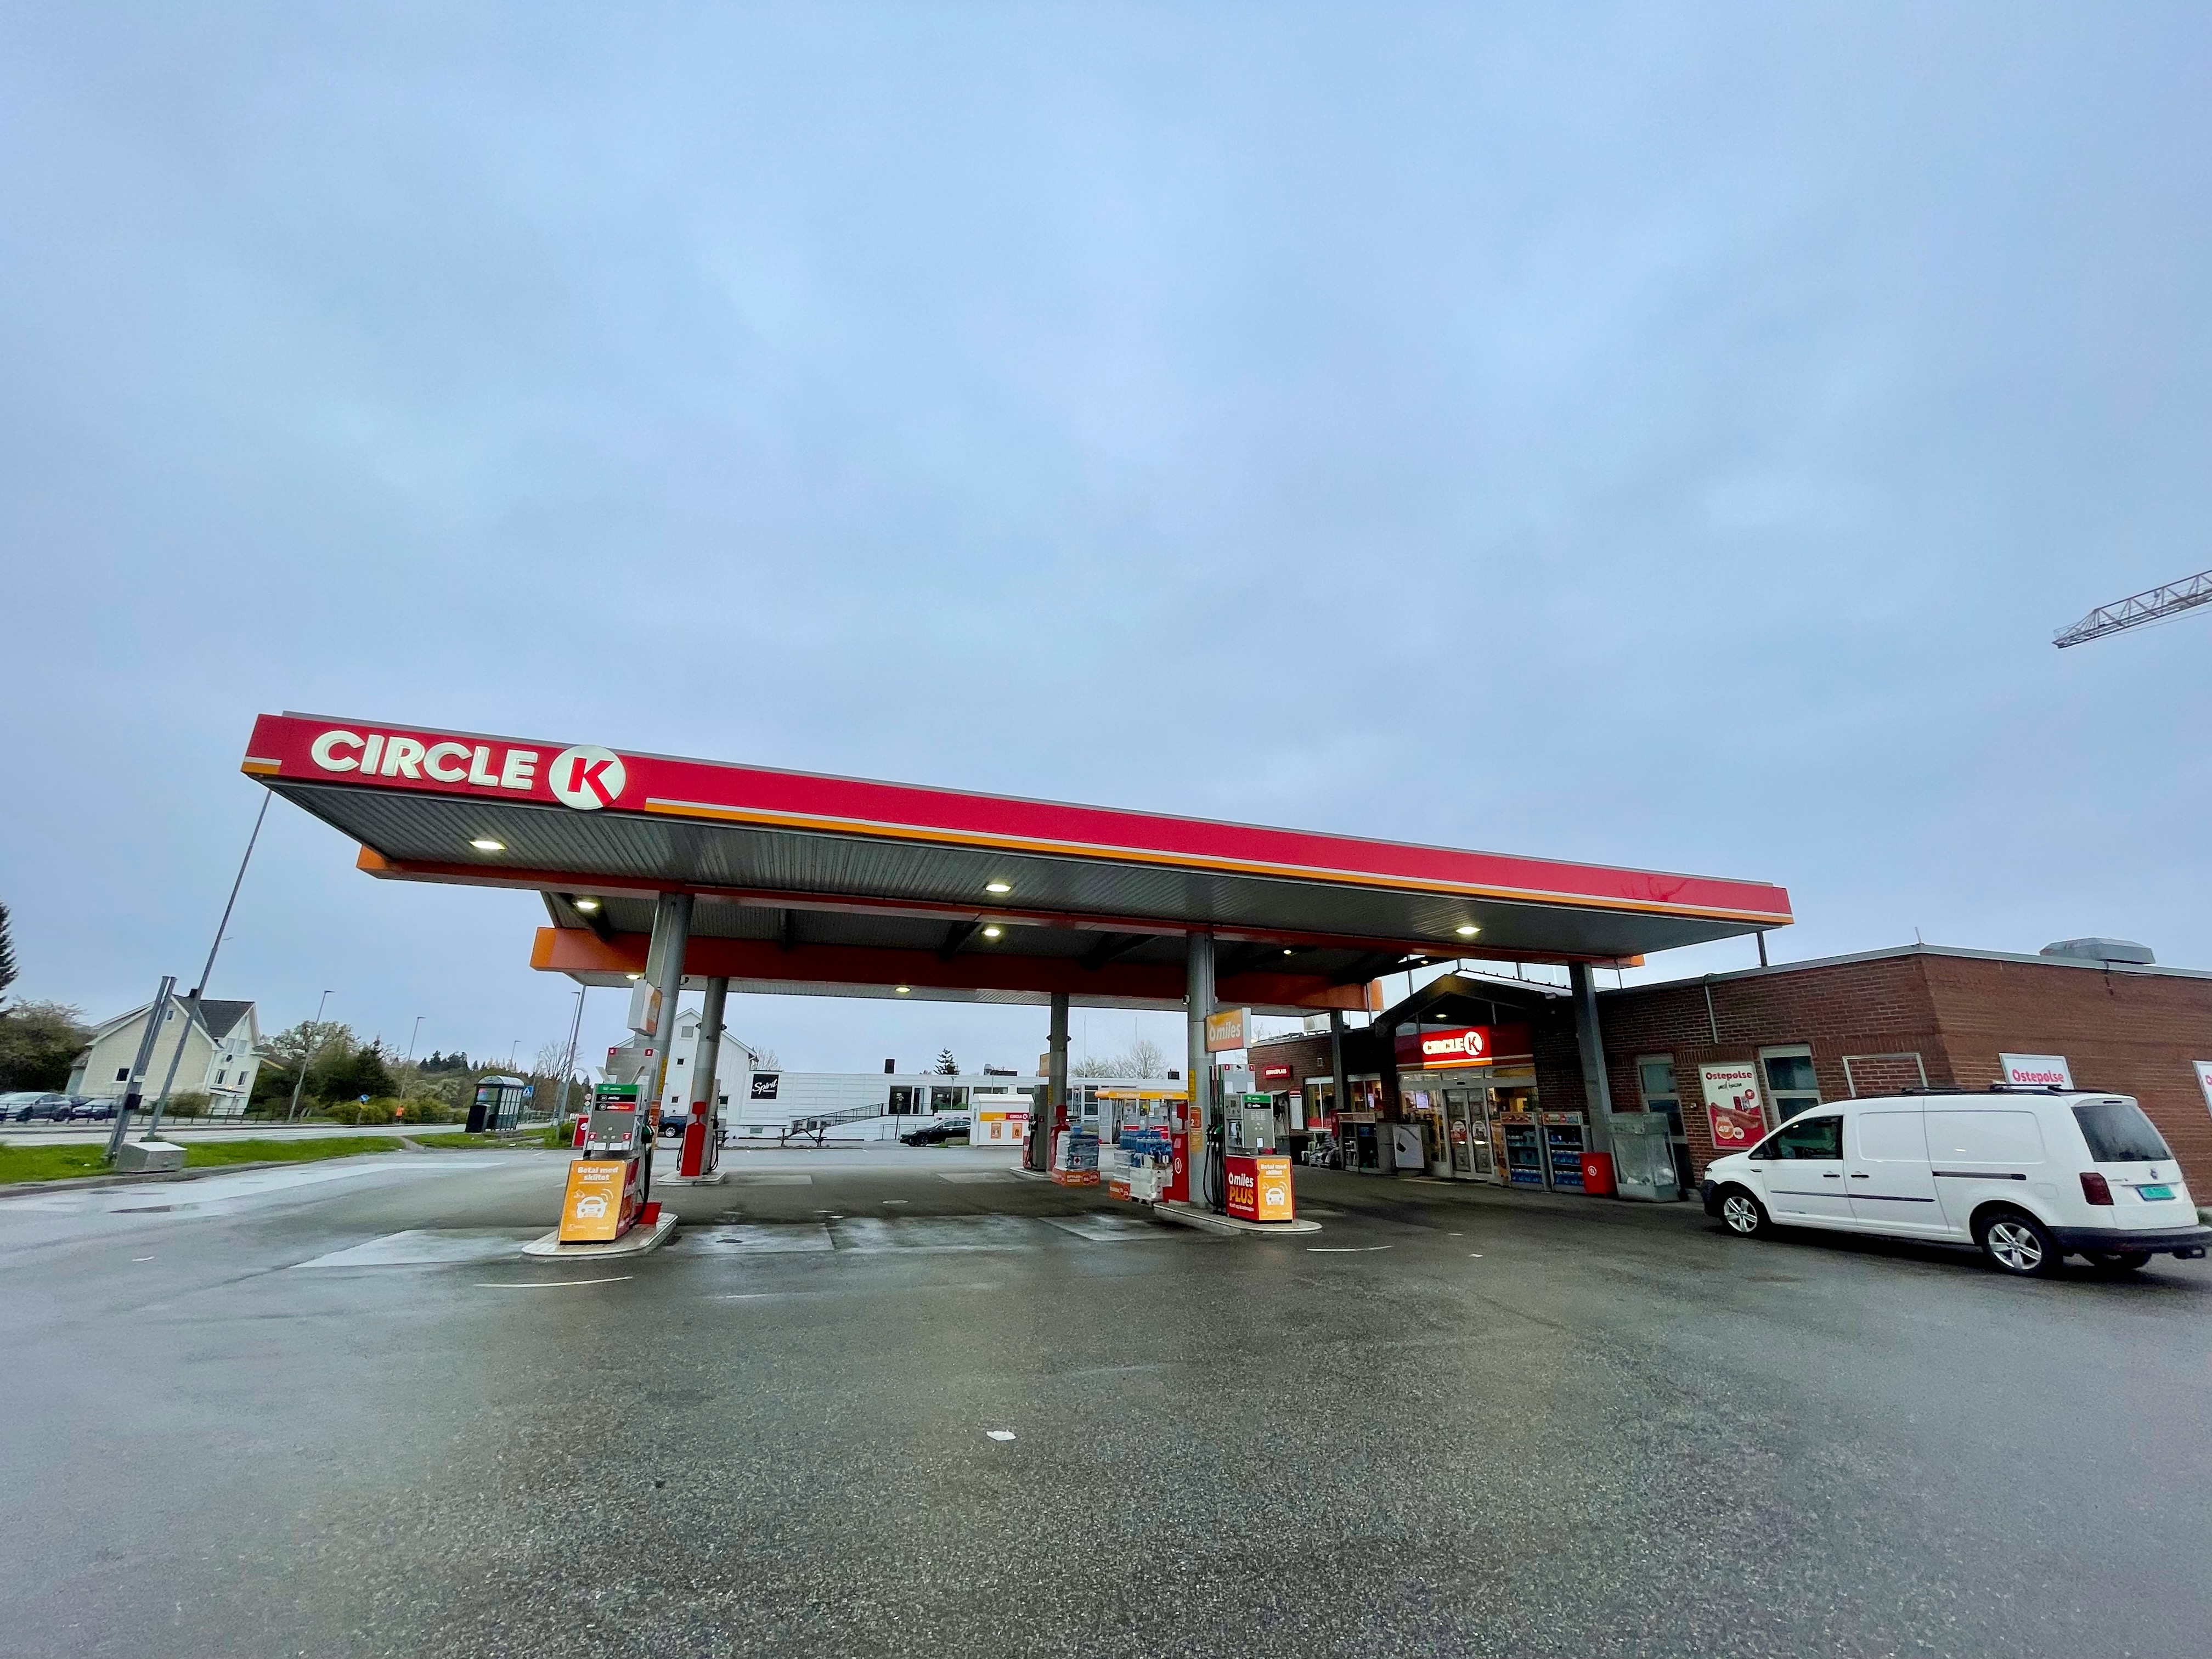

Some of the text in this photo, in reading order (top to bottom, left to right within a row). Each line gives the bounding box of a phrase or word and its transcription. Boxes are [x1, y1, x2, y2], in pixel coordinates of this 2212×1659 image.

[311, 730, 616, 808] CIRCLE K
[1423, 1037, 1464, 1054] CIRCLE
[752, 1078, 777, 1094] Spirit
[1229, 1186, 1254, 1205] PLUS
